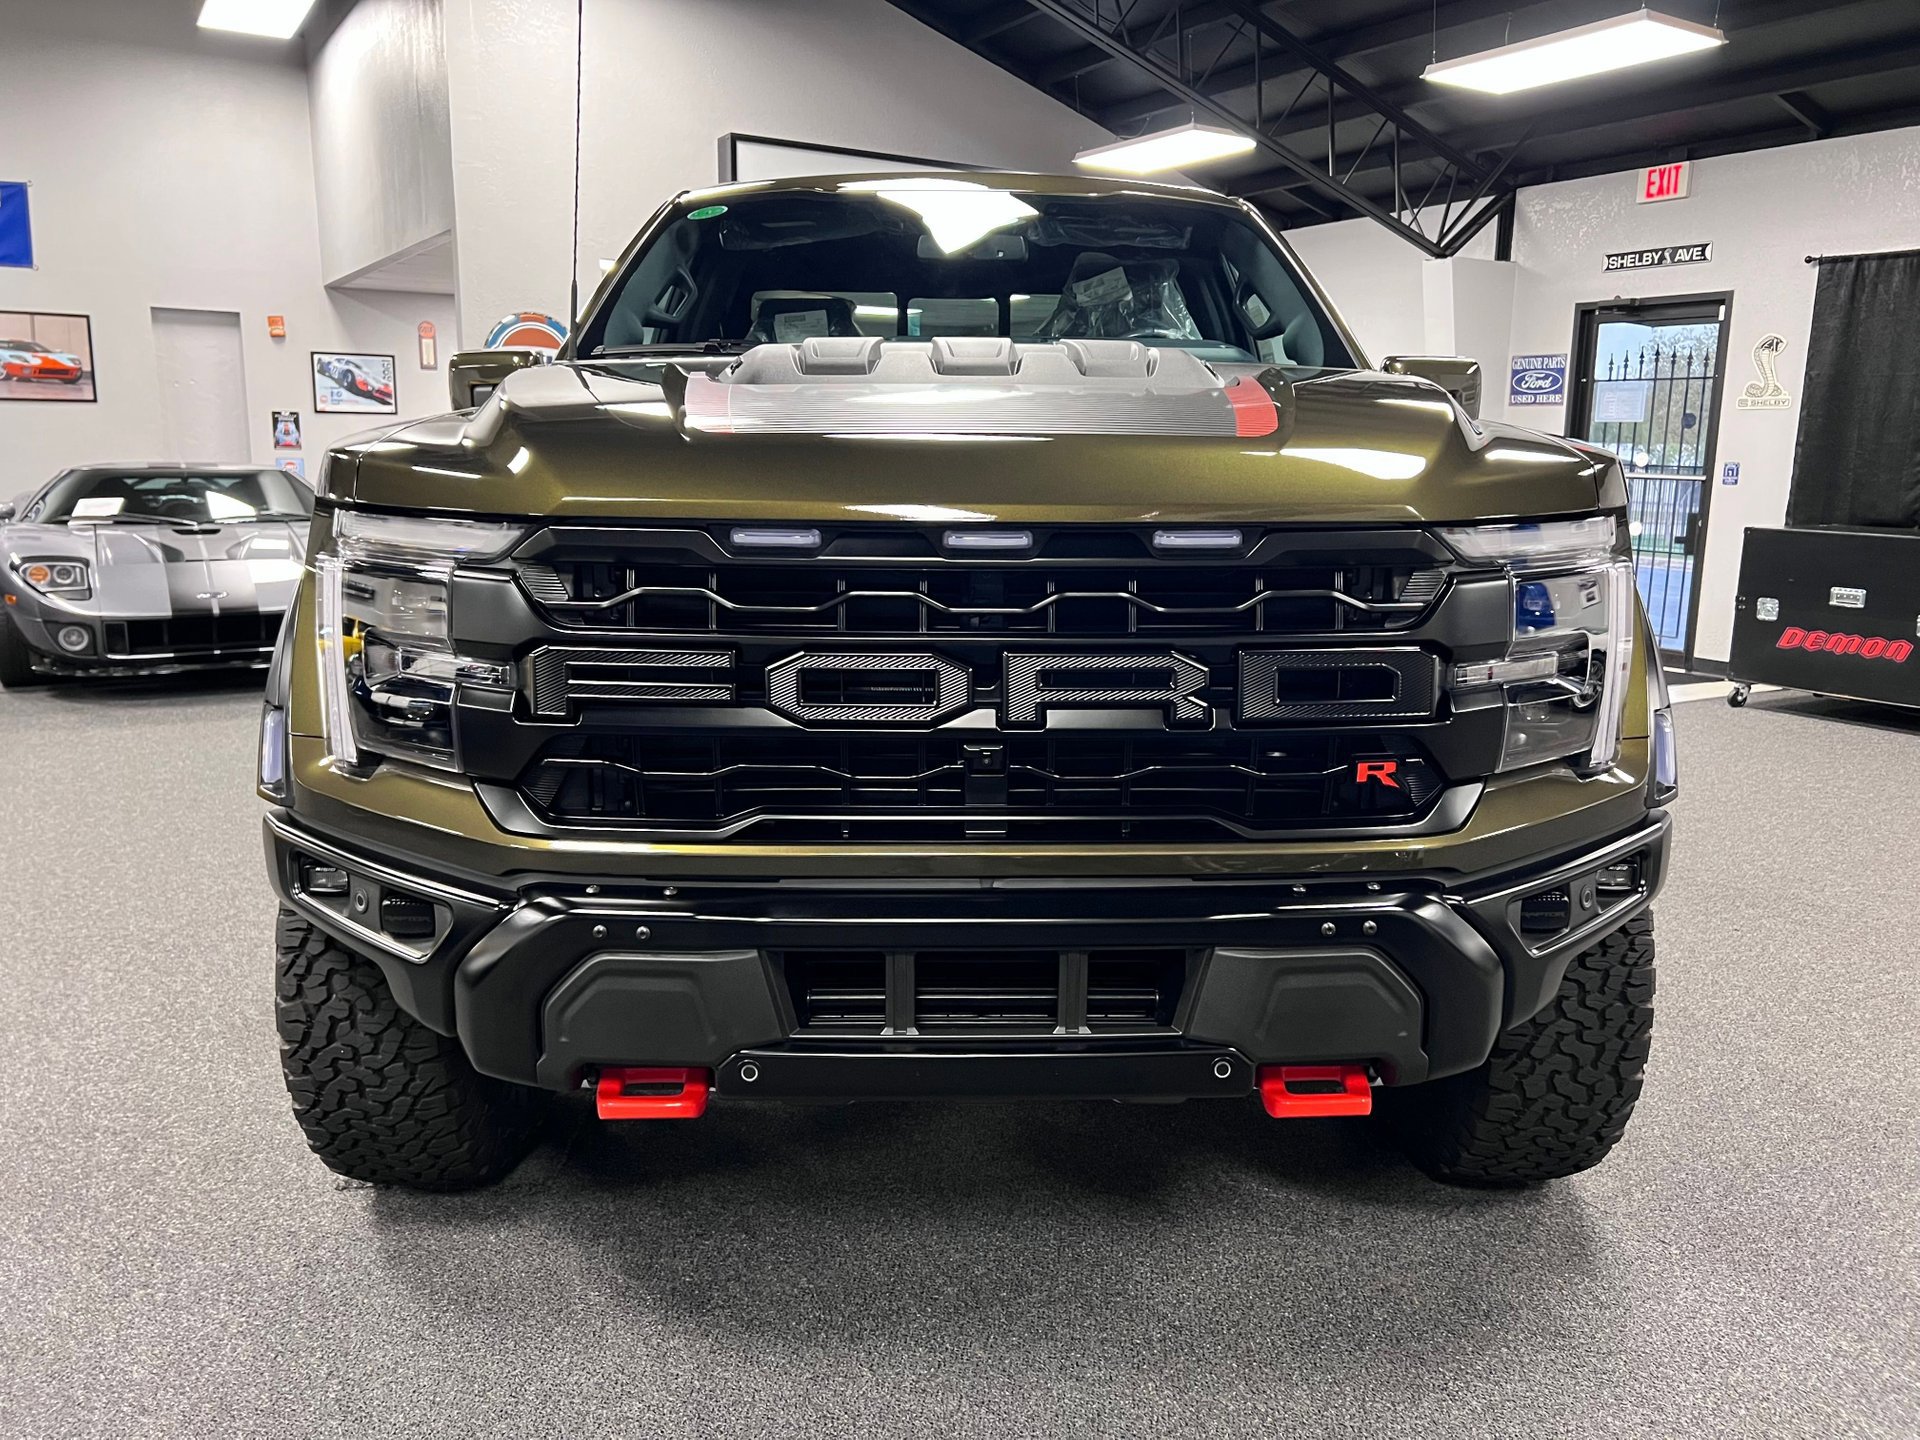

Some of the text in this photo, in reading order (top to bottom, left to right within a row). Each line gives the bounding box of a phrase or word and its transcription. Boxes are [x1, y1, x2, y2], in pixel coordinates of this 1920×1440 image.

[1645, 164, 1683, 199] EXIT
[1608, 247, 1704, 269] SHELBY AVE.
[1512, 356, 1566, 370] GENUINE PARTS
[1521, 373, 1553, 389] Ford
[1511, 394, 1562, 403] USED HERE
[1776, 626, 1914, 663] DEMON
[527, 645, 1438, 724] FORD
[1356, 761, 1400, 788] R
